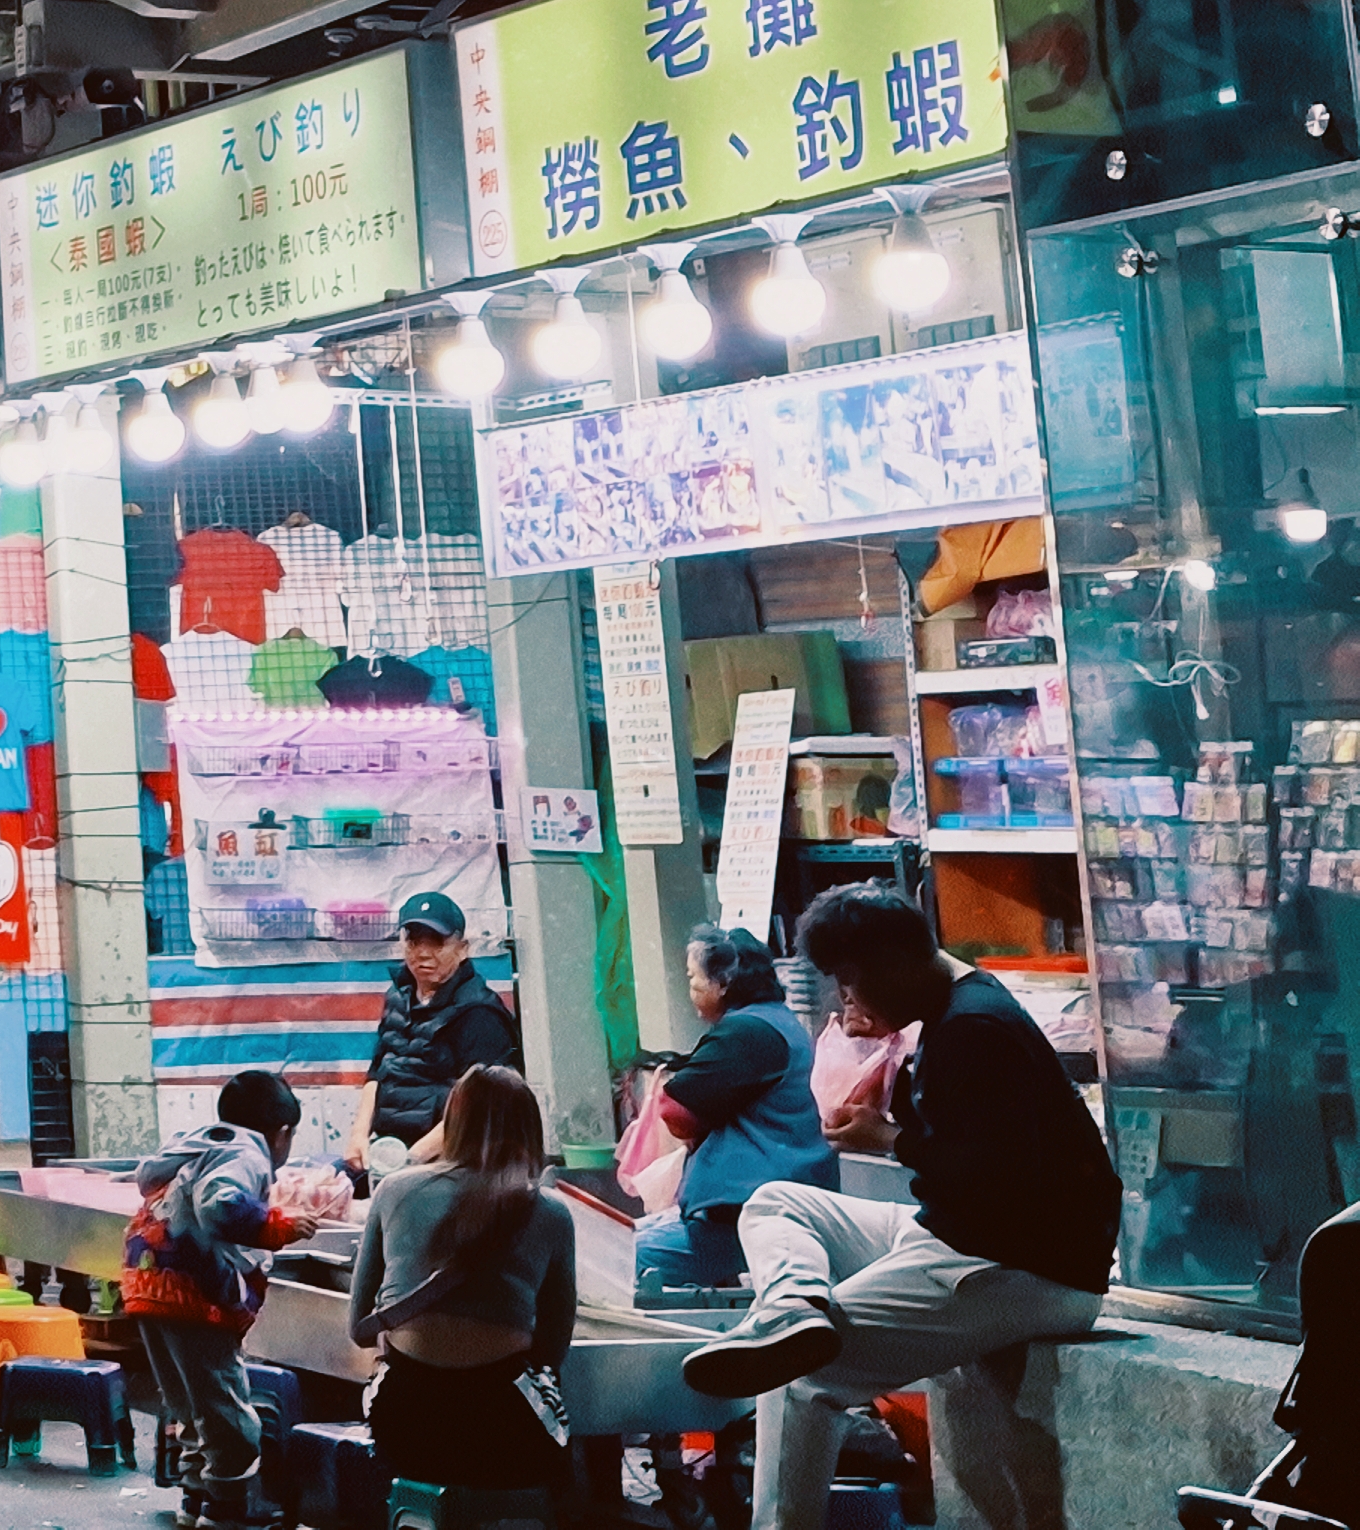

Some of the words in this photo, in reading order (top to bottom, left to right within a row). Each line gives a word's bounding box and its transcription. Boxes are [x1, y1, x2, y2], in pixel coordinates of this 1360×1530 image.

[34, 143, 176, 232] 迷你釣蝦
[221, 87, 362, 176] えび釣り
[541, 38, 970, 241] 撈魚、釣蝦
